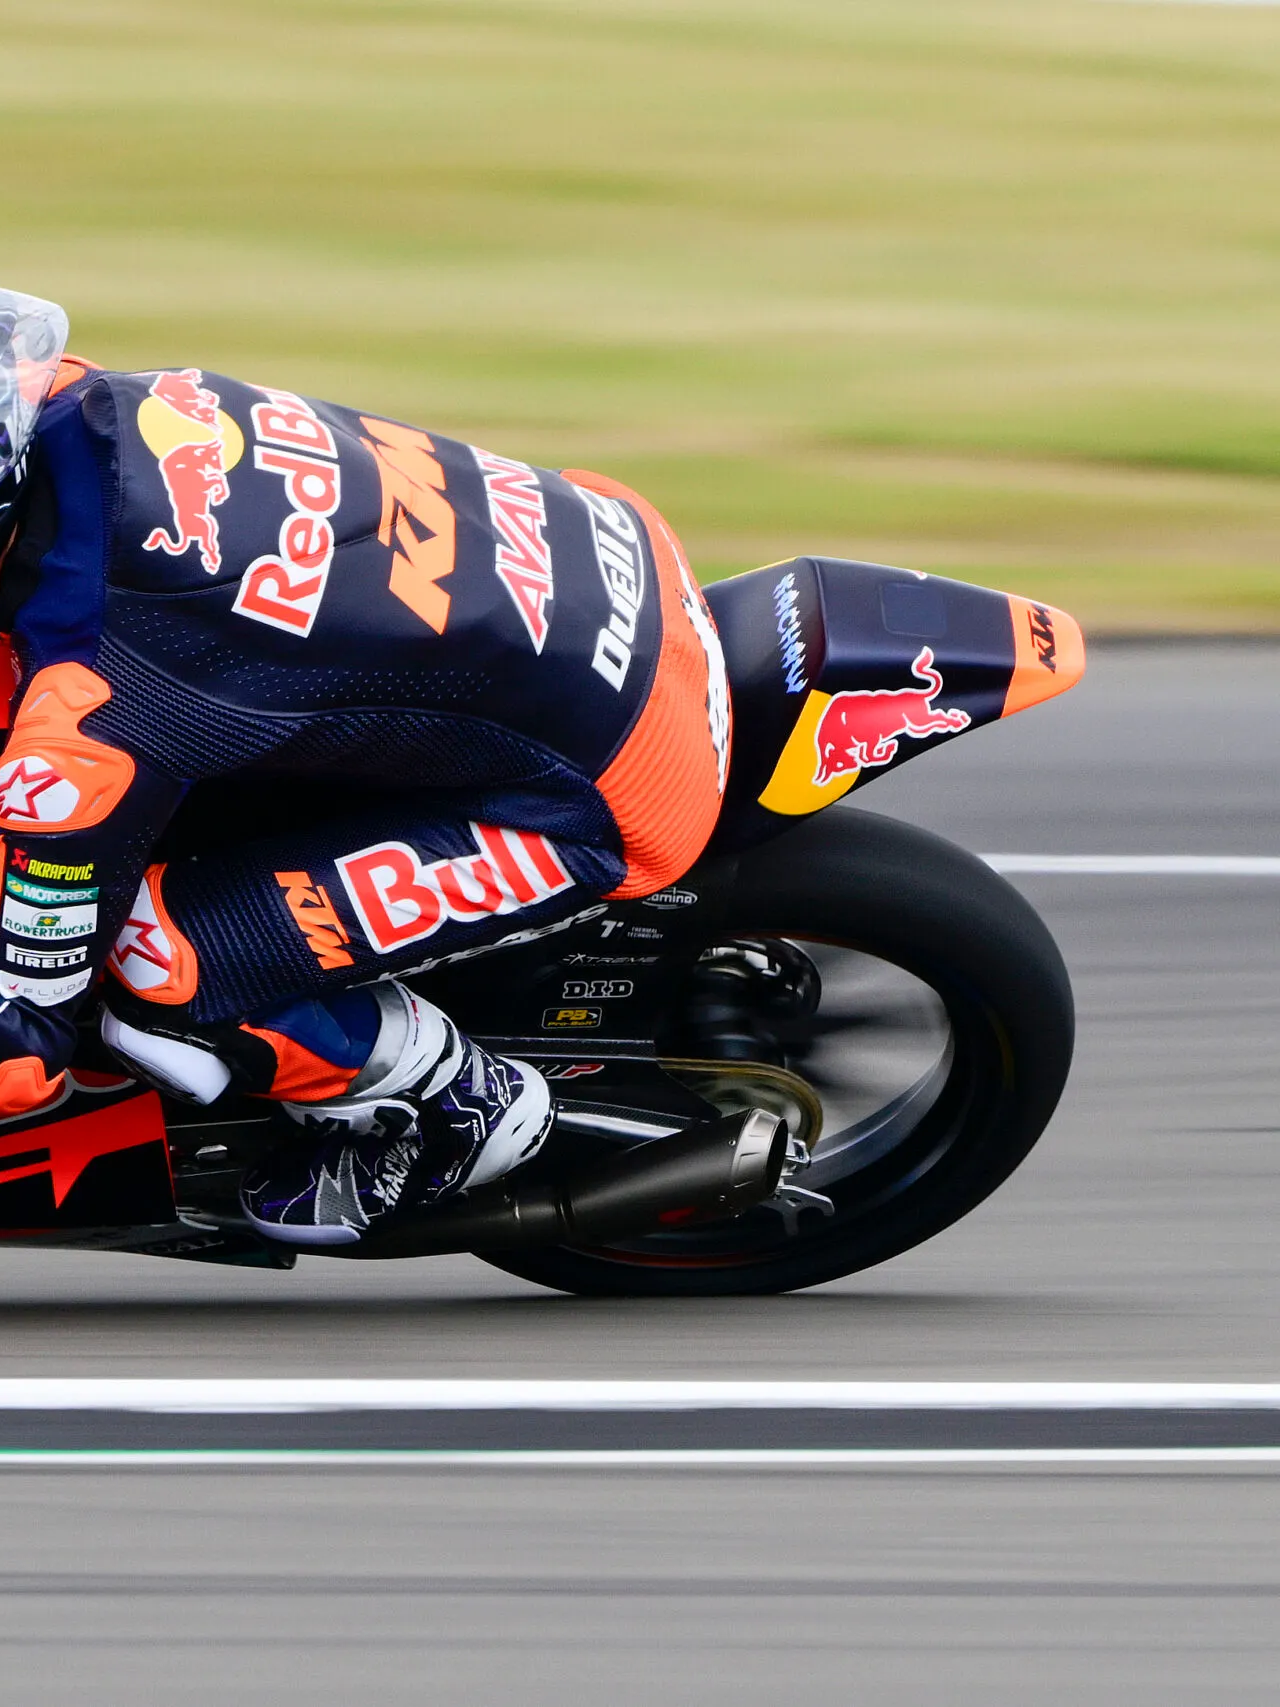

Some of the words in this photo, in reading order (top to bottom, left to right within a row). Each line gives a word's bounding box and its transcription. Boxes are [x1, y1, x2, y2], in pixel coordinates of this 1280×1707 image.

[230, 444, 341, 639] Red
[359, 415, 456, 636] KTM
[1027, 602, 1057, 674] KTM
[4, 918, 93, 937] FLOWERTRUCKS
[23, 882, 93, 902] MOTOREX
[274, 871, 355, 970] KTM
[334, 820, 576, 954] Bull
[6, 943, 88, 969] PIRELLI
